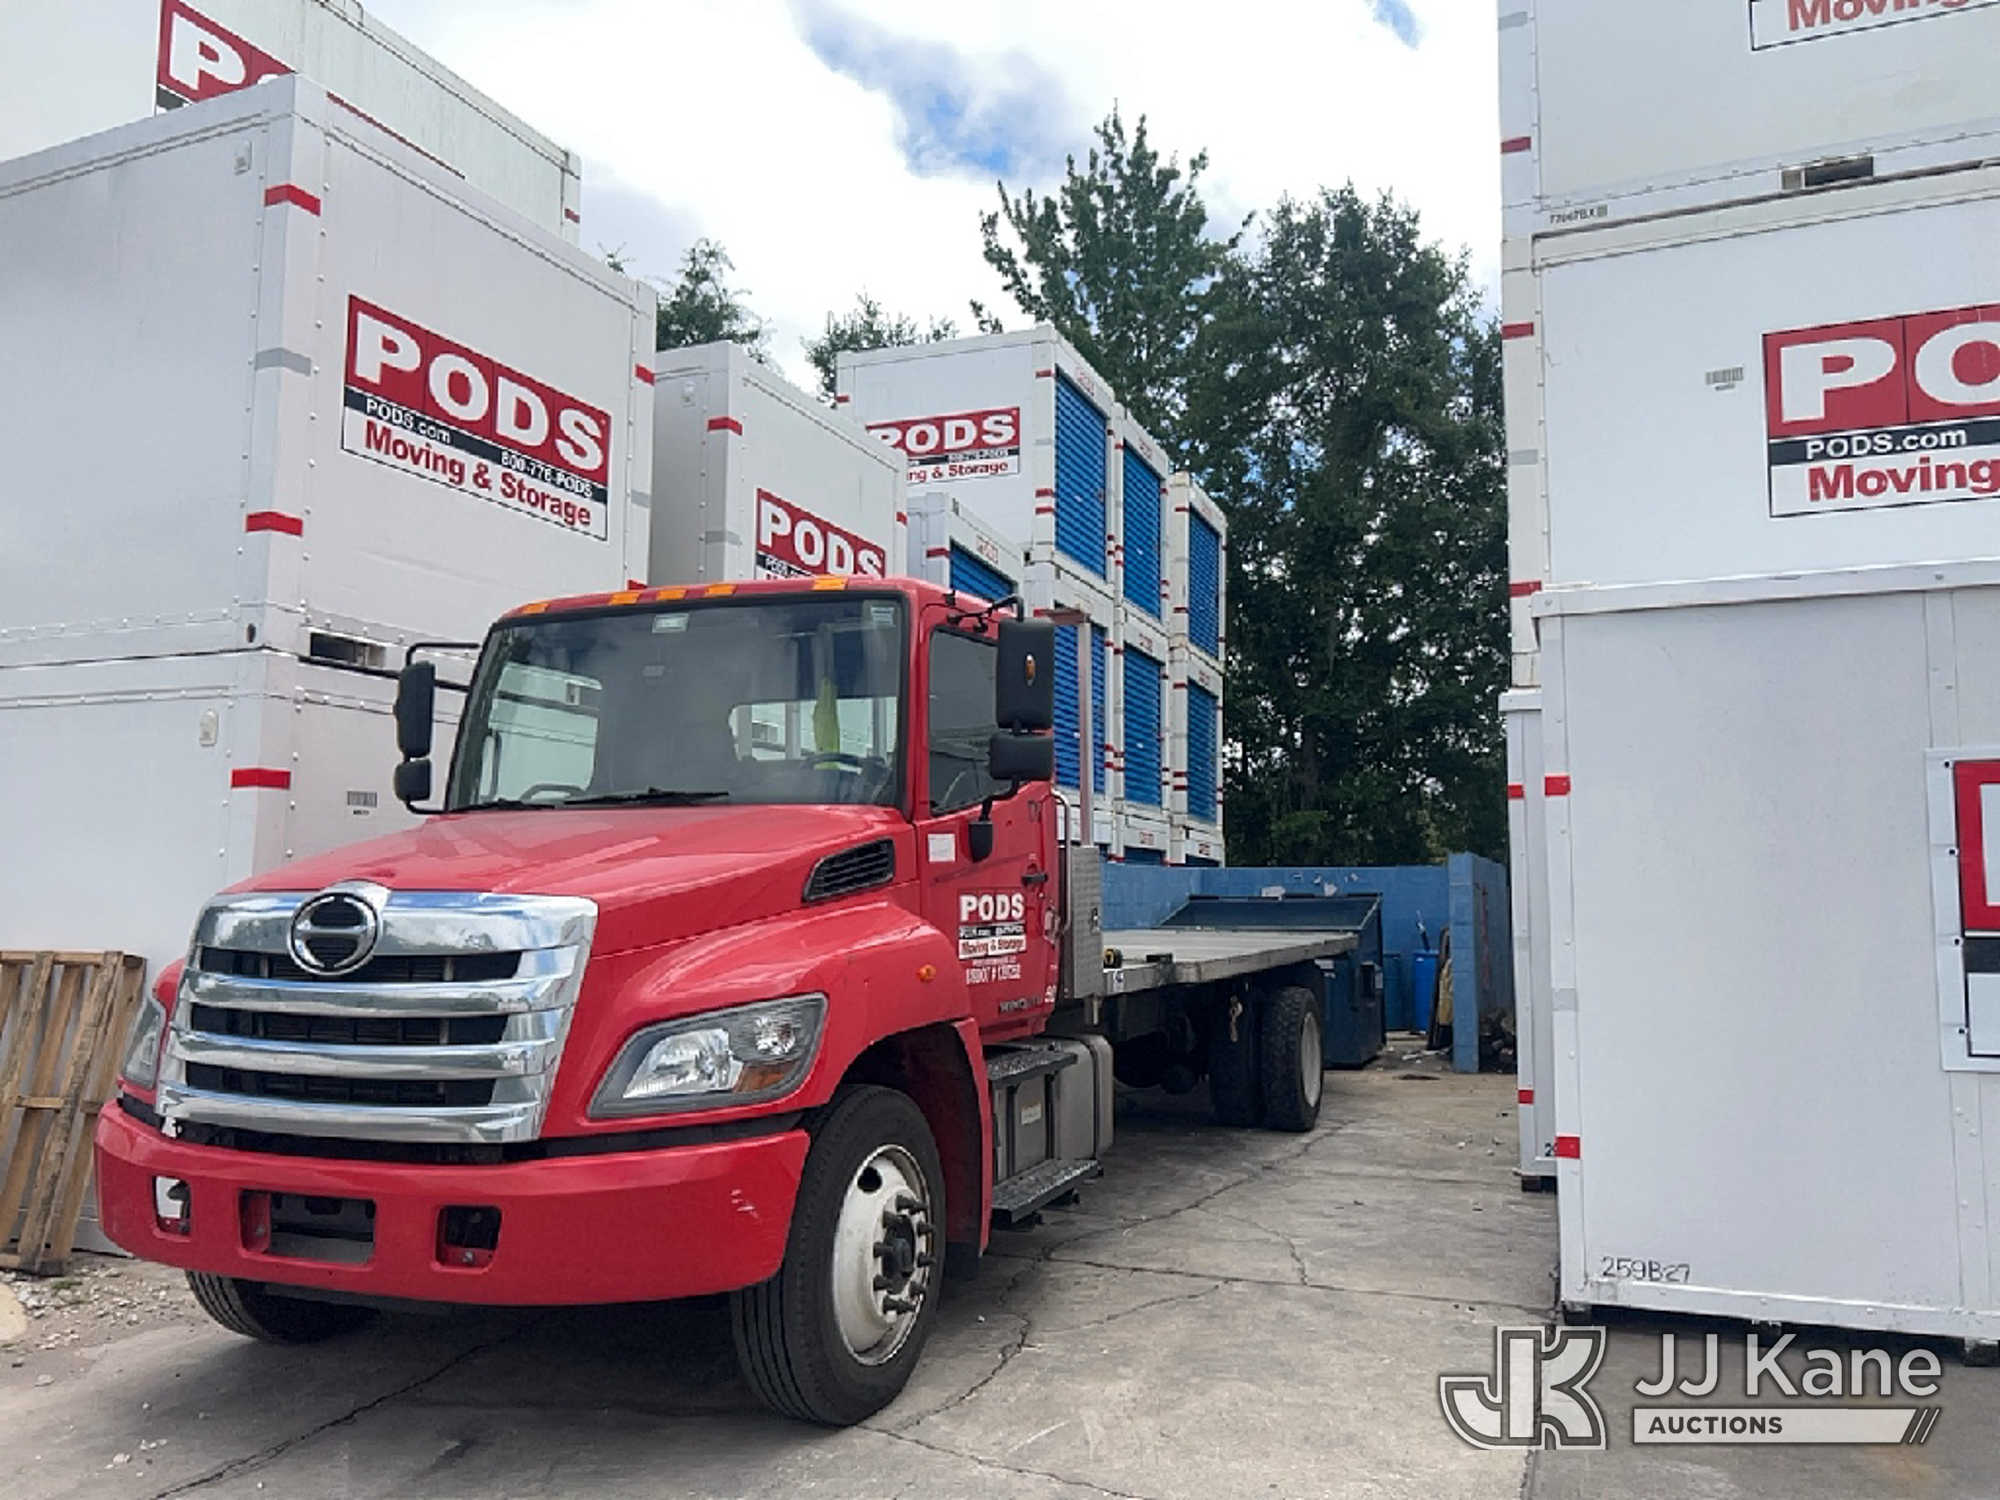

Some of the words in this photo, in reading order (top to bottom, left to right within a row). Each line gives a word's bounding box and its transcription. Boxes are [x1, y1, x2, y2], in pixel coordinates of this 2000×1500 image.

[354, 311, 604, 471] PODS
[366, 398, 451, 444] PODS.com
[867, 414, 1016, 453] PODS
[1806, 429, 1967, 460] PODS.com
[365, 421, 466, 486] Moving
[472, 461, 492, 492] &
[500, 471, 591, 527] Storage
[932, 466, 943, 479] &
[949, 462, 1009, 478] Storage
[1809, 456, 2000, 502] Moving
[760, 500, 883, 578] PODS
[960, 893, 1025, 922] PODS
[1602, 1256, 1690, 1284] 259B27
